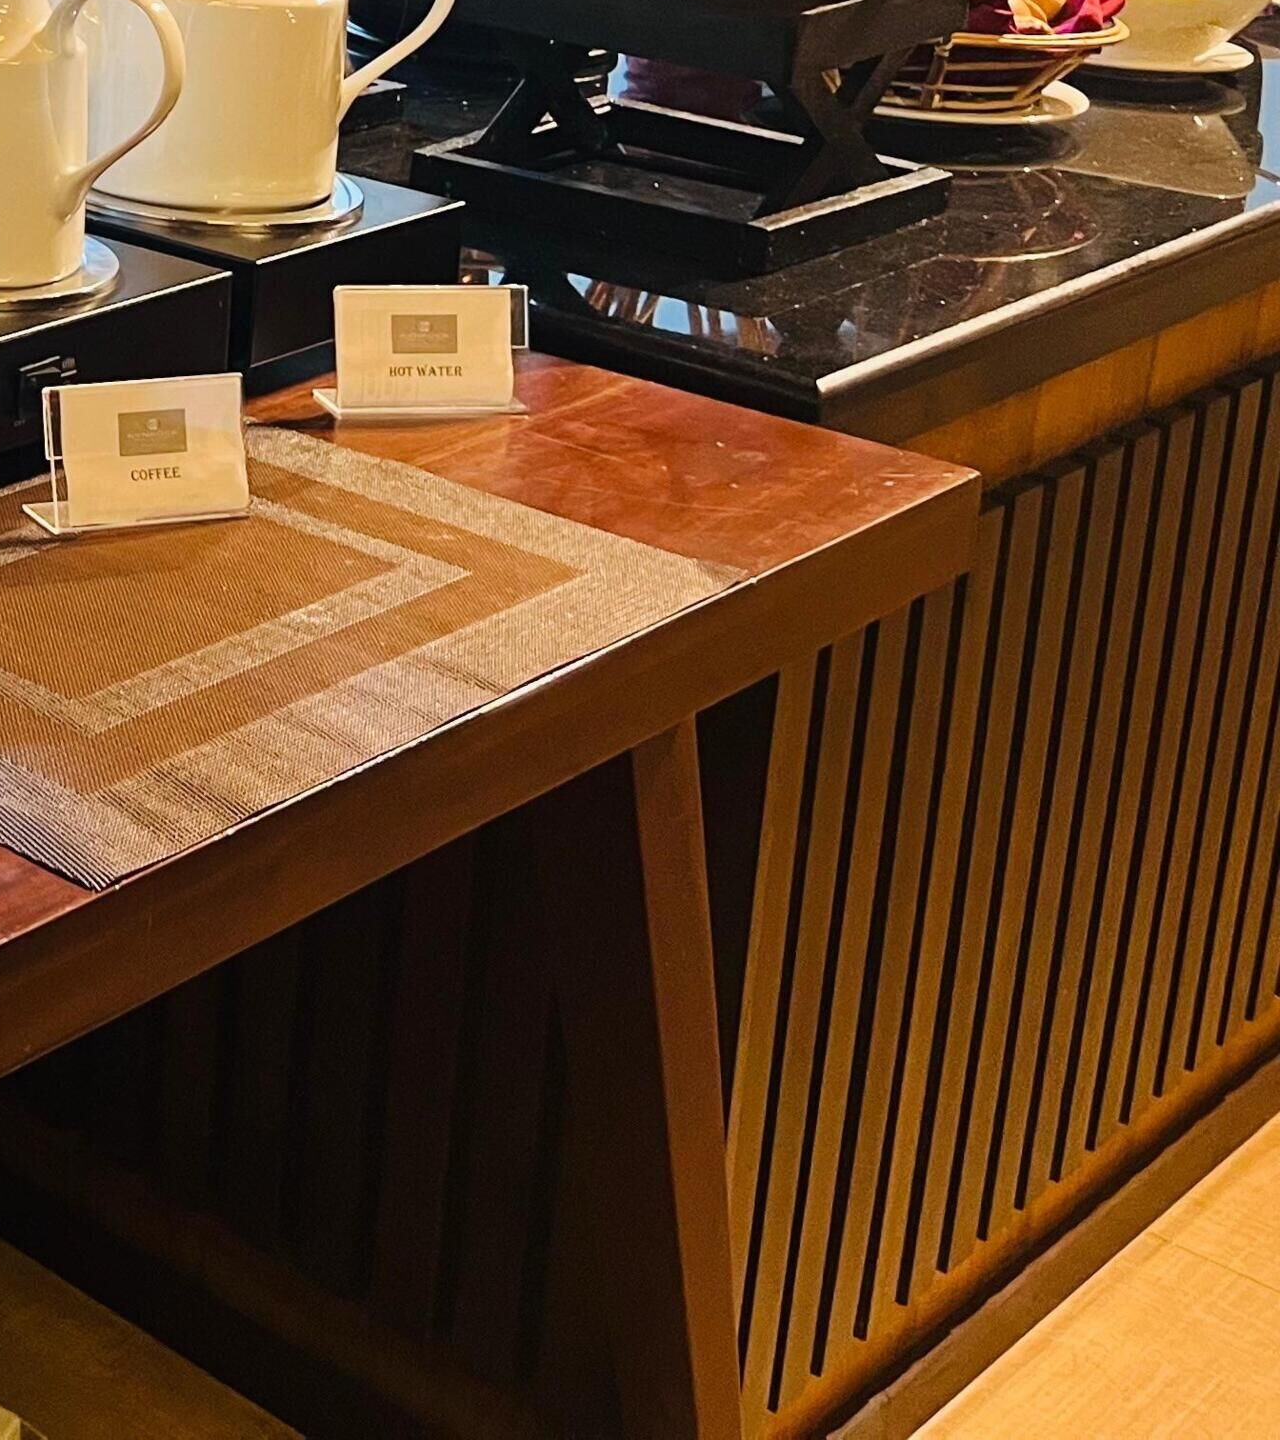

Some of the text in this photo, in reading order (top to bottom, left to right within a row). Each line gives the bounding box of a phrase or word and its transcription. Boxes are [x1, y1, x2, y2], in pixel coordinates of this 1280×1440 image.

[388, 365, 462, 377] HOT WATER
[131, 466, 181, 481] COFFEE
